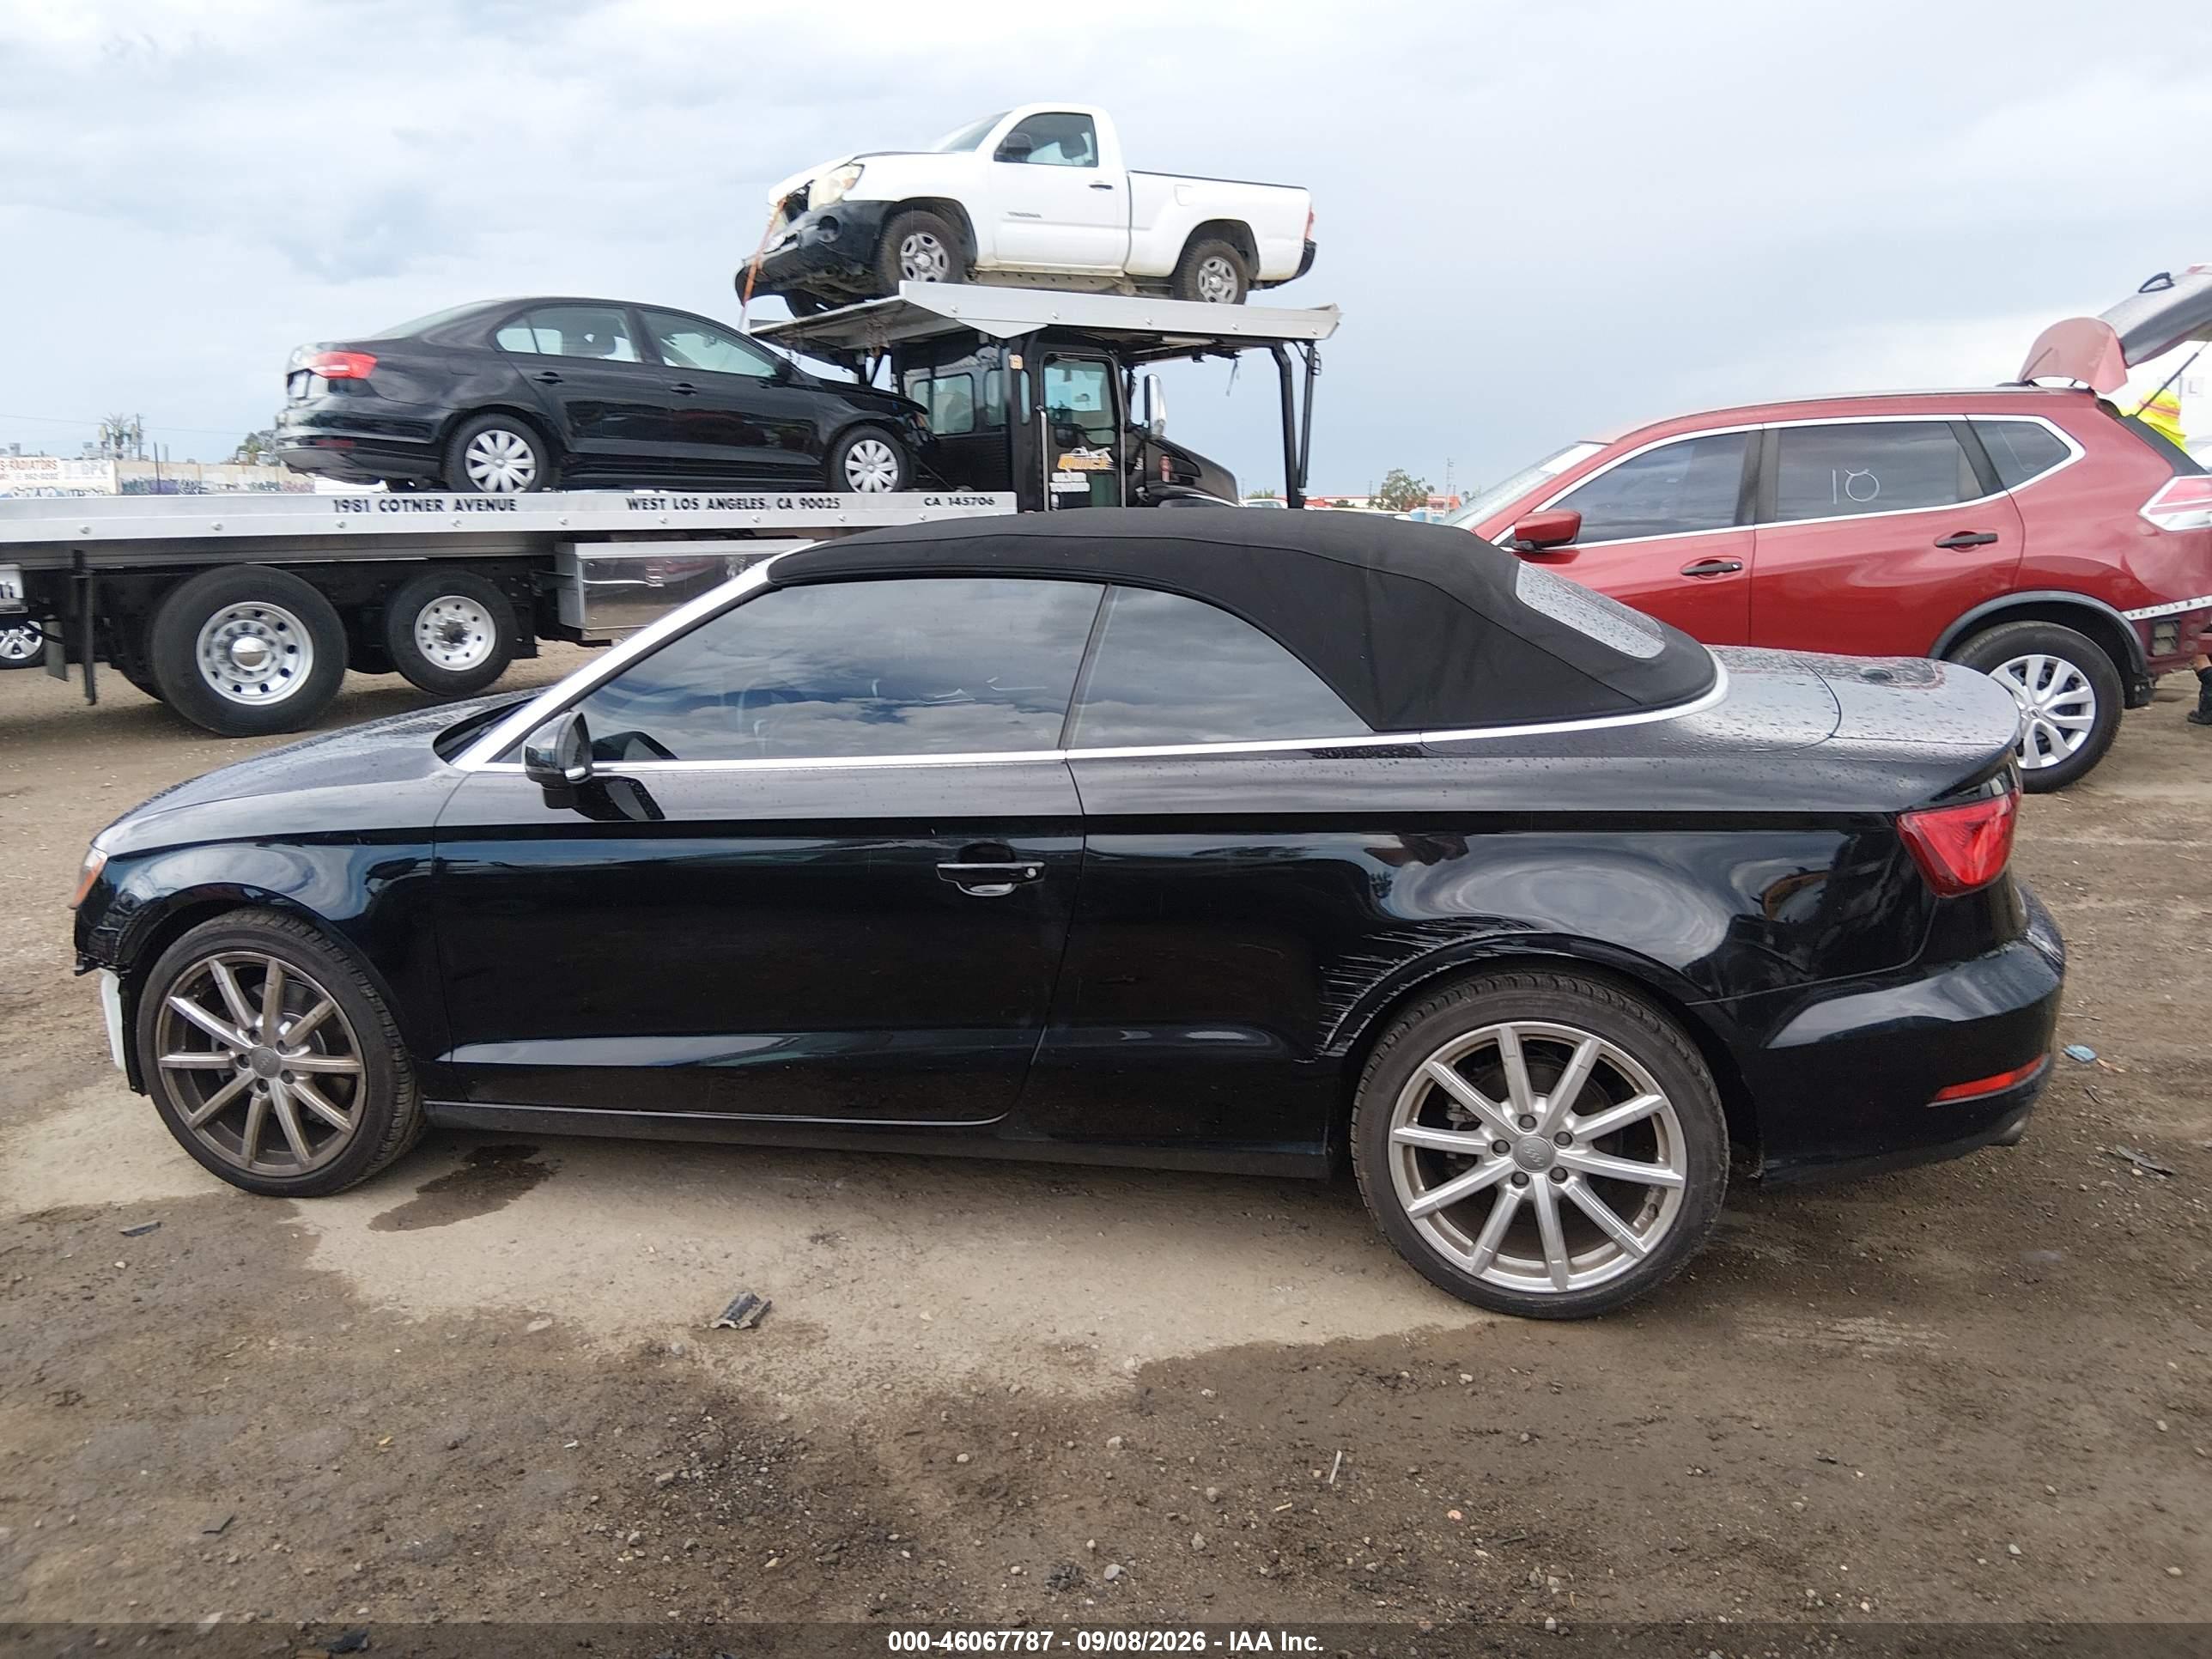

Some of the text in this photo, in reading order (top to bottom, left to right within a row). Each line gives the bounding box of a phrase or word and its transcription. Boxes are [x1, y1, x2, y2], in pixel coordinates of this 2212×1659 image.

[1832, 468, 1881, 505] 10
[333, 498, 518, 513] 1981 COTNER AVENUE
[626, 497, 667, 511] WEST
[673, 497, 700, 510] LOS
[777, 497, 793, 510] CA
[799, 497, 842, 509] 90025
[924, 496, 996, 507] CA 145706
